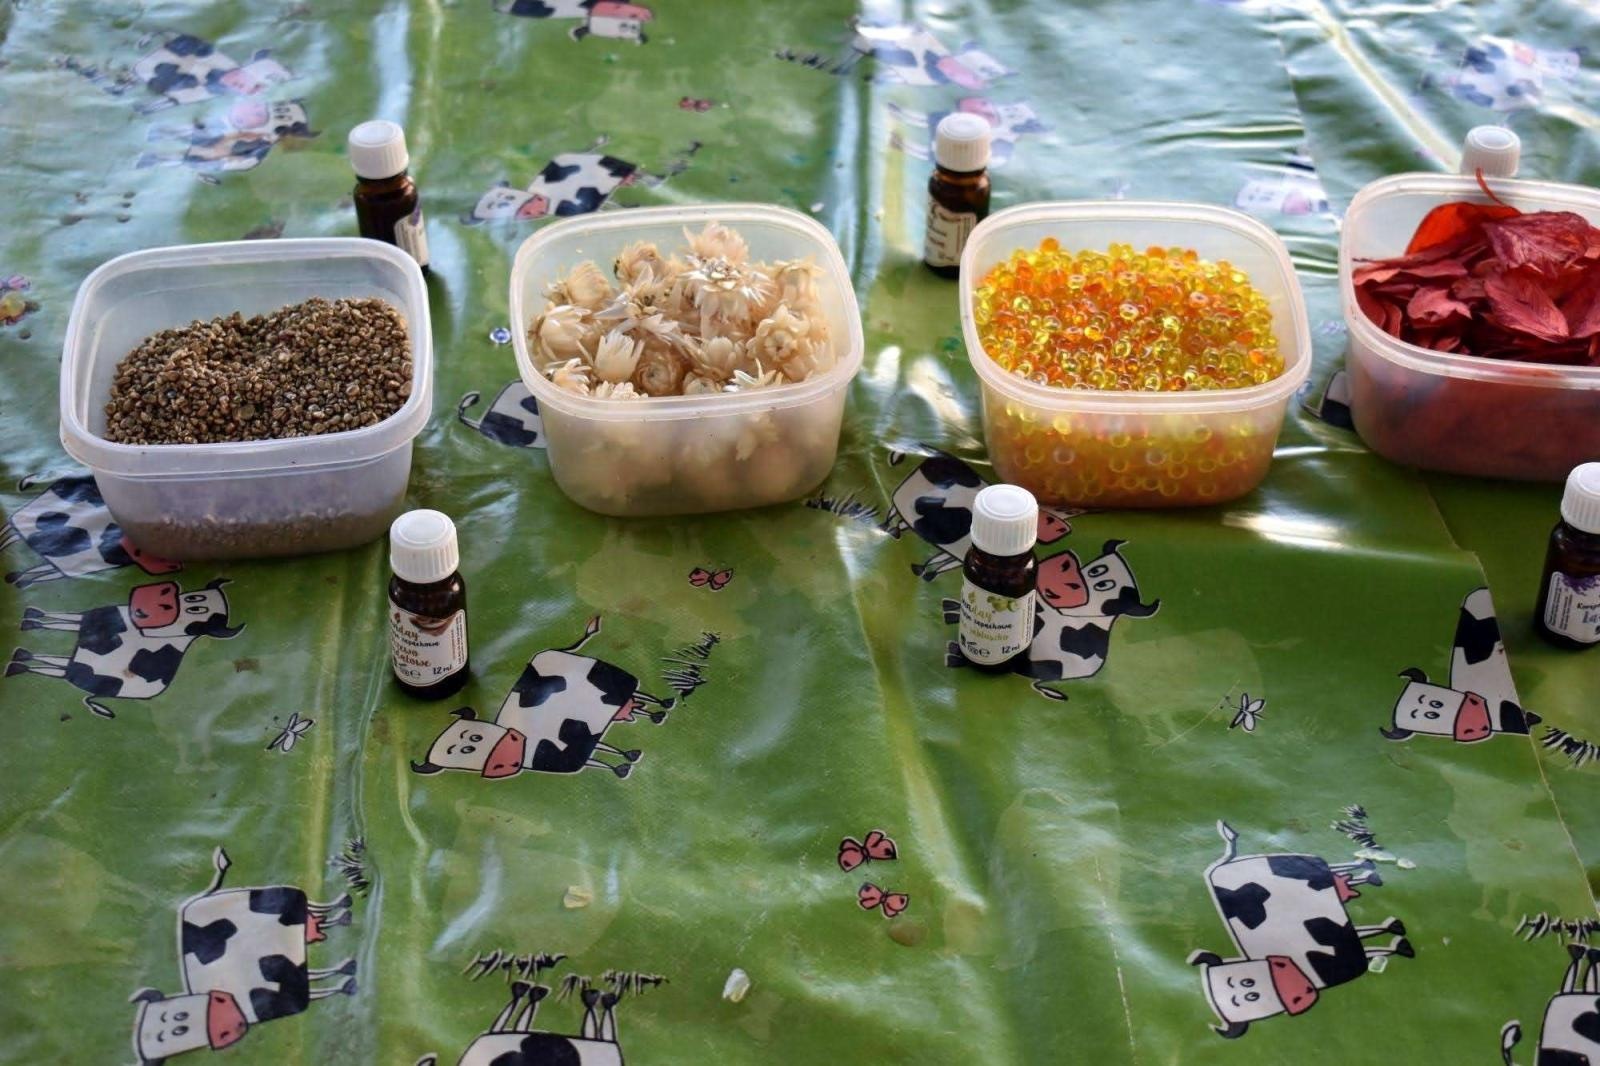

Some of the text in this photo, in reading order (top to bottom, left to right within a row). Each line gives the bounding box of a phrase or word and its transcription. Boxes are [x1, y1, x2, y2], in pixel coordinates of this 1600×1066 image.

[1002, 646, 1010, 654] 12
[432, 664, 453, 675] 12 ml
